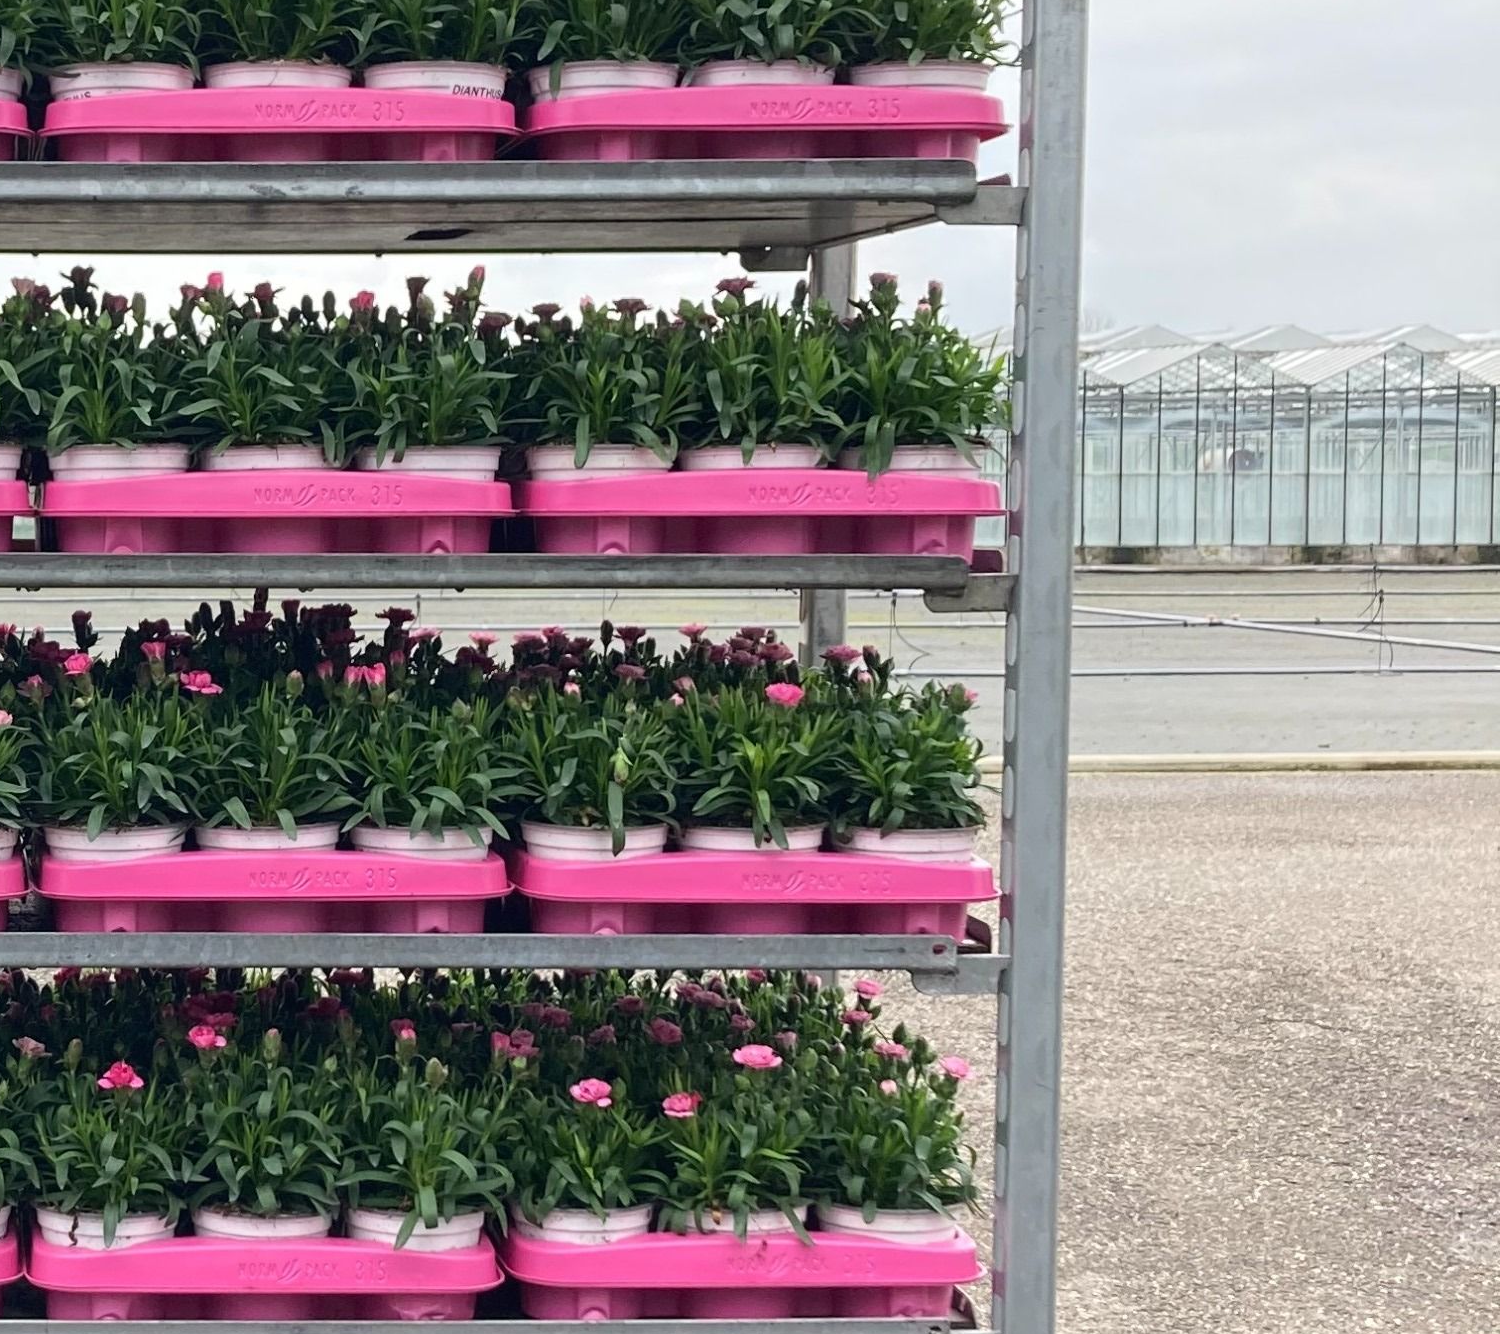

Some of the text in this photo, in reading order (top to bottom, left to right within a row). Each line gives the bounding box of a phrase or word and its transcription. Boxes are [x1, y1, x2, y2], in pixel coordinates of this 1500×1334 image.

[452, 84, 503, 100] DIANTHUS
[255, 100, 405, 122] NORM PACK 315
[749, 98, 900, 118] NORM PACK 315
[253, 484, 402, 505] NORM PACK 315
[748, 482, 899, 505] NORM PACK 315
[249, 867, 398, 890] NORM PACK 315
